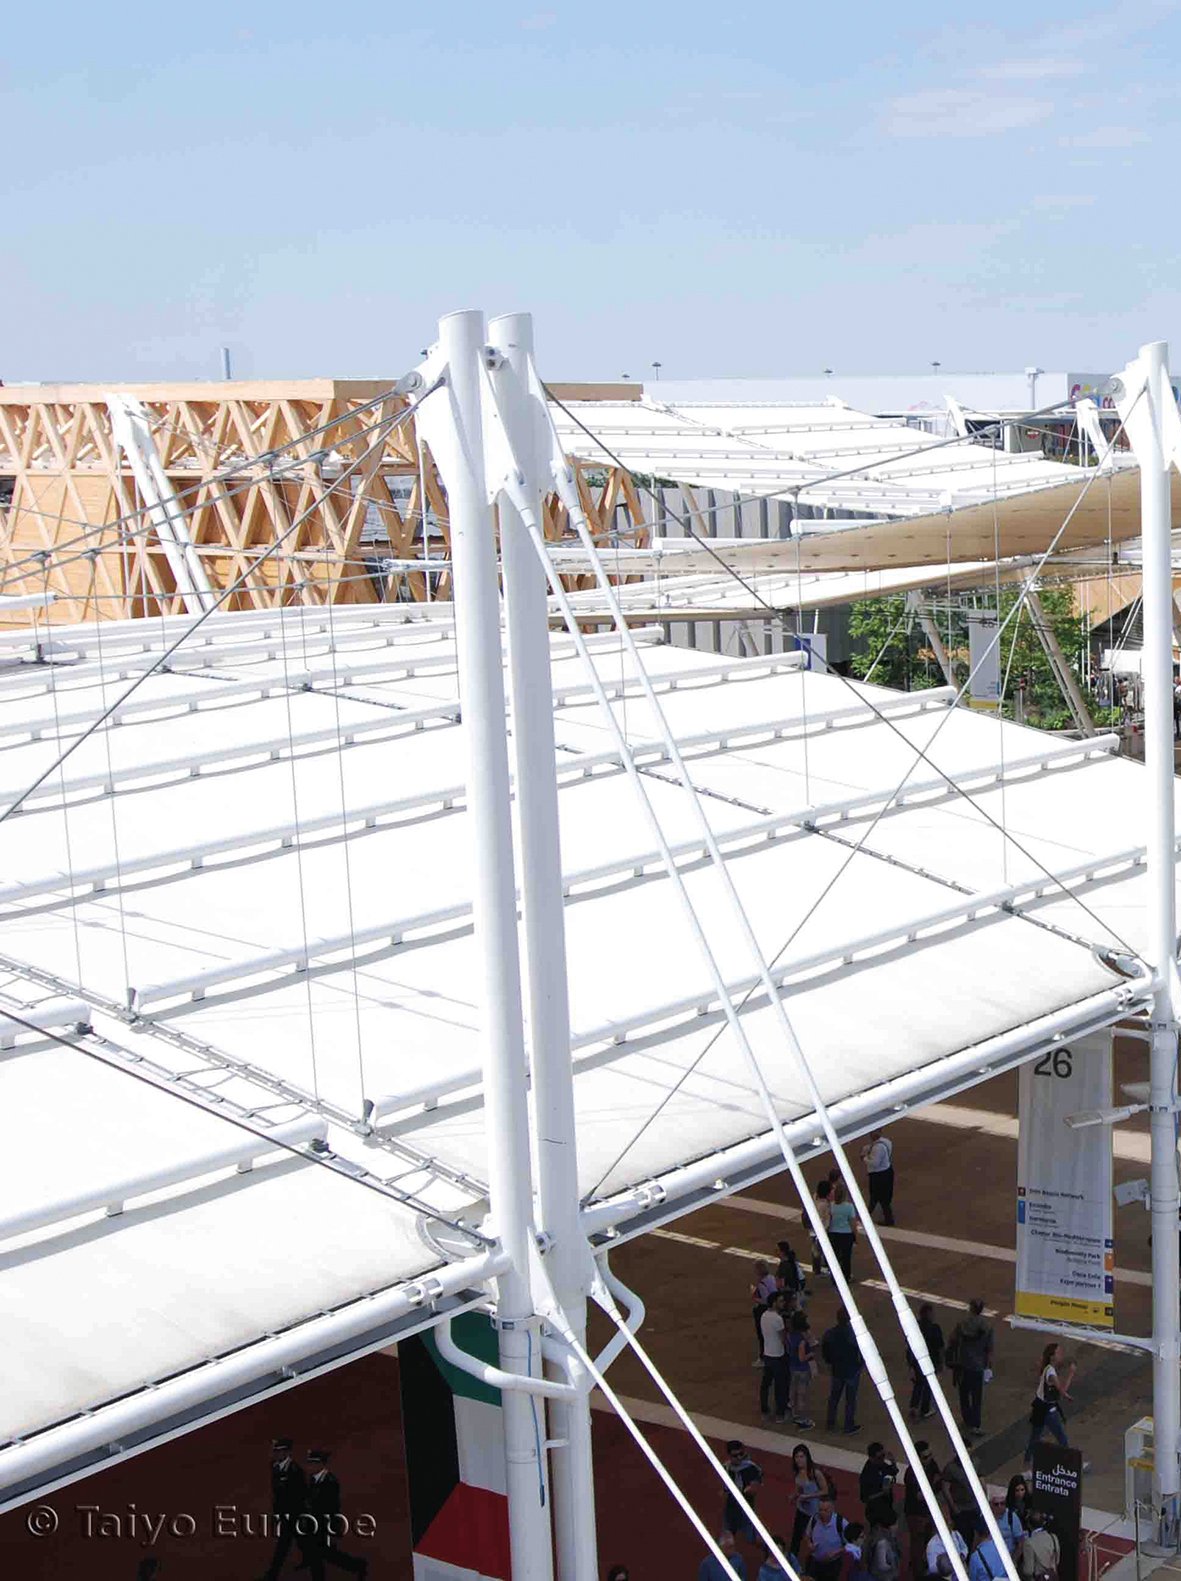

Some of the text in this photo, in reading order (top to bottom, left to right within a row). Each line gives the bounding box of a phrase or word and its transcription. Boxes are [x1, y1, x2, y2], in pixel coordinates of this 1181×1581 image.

[1034, 1047, 1072, 1078] 26
[1052, 1464, 1077, 1478] مدخل
[1036, 1471, 1077, 1489] Entrance
[1036, 1480, 1069, 1496] Entrata
